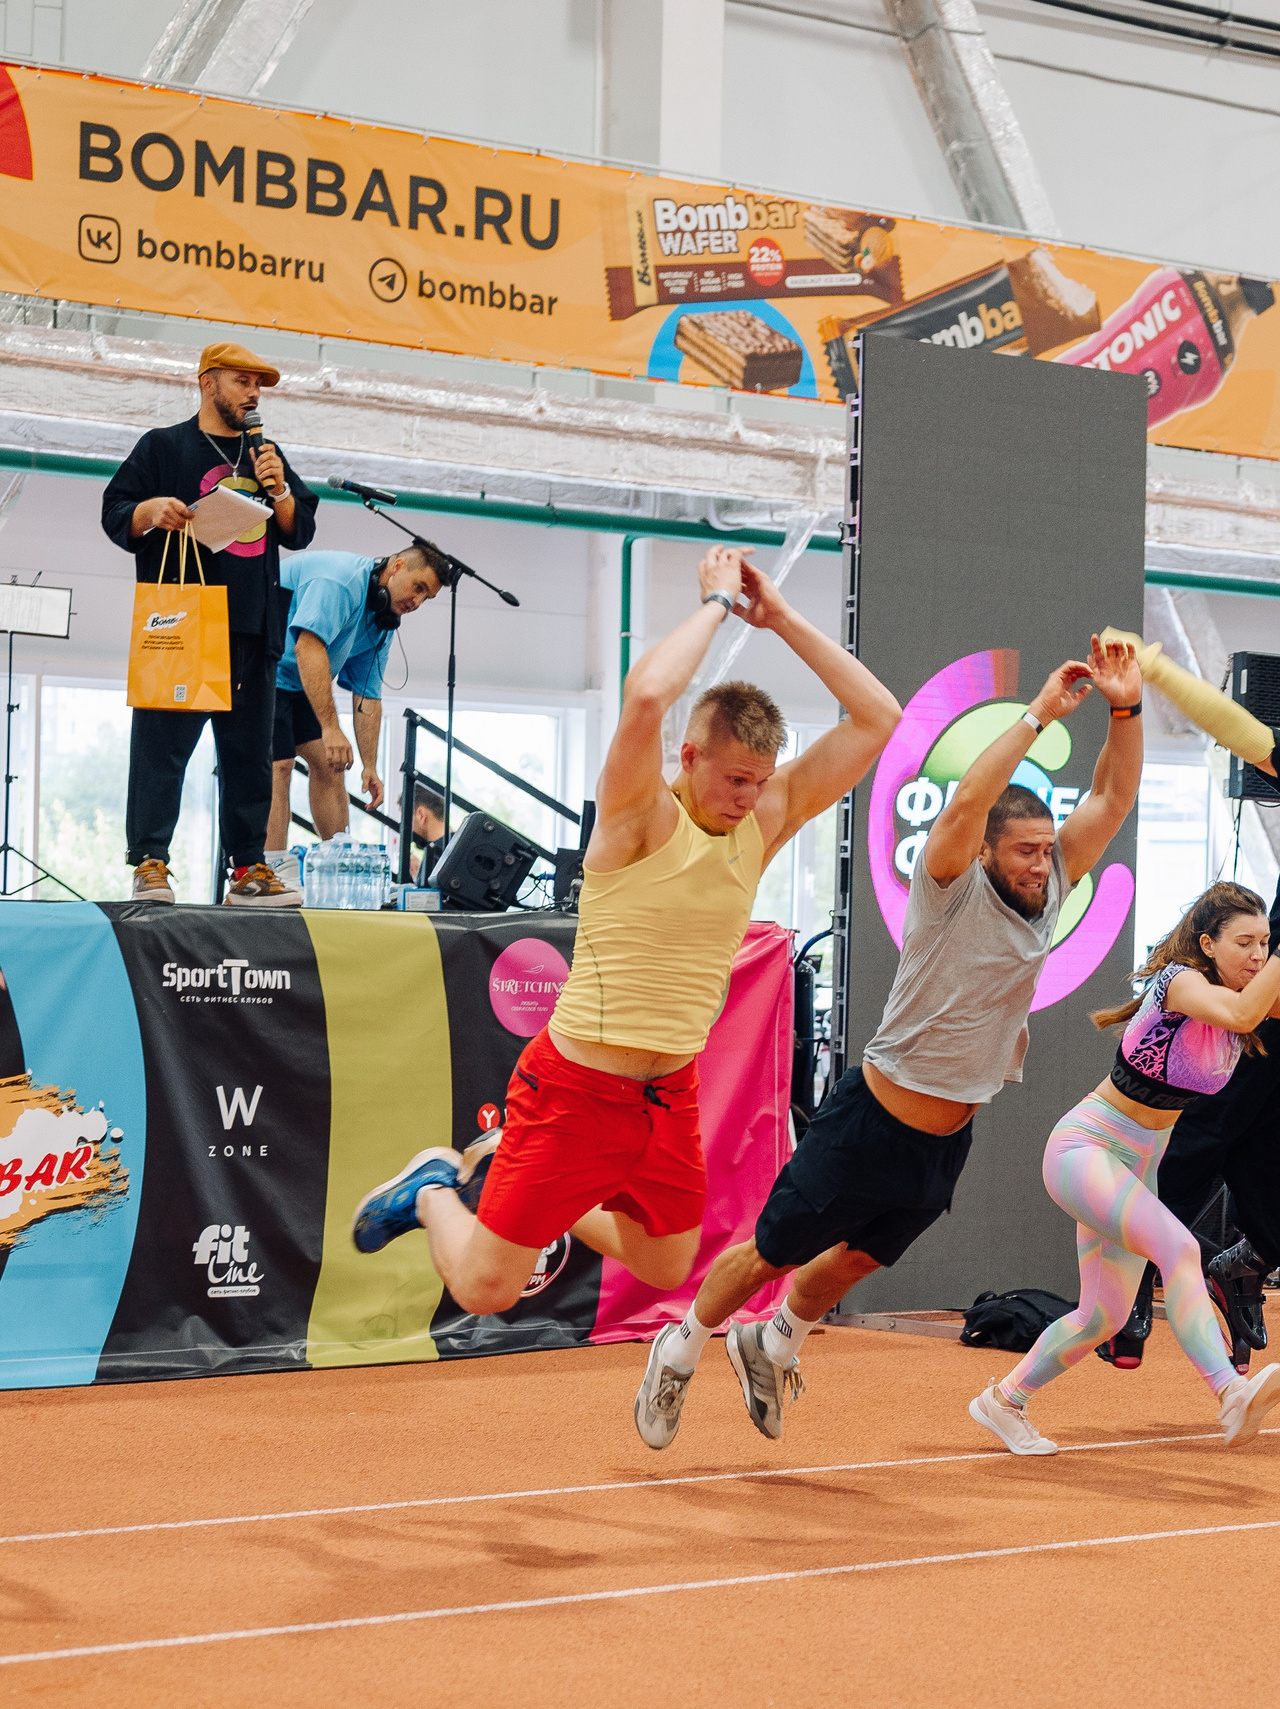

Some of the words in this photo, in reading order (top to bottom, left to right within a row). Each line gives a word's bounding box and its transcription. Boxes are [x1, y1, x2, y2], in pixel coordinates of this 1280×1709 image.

[79, 121, 560, 251] BOMBBAR.RU
[653, 195, 799, 233] Bombbar
[137, 228, 325, 284] bombbarru
[658, 230, 739, 256] WAFER
[749, 246, 782, 263] 22%
[418, 270, 558, 317] bombbar
[1082, 289, 1182, 371] TONIC
[162, 958, 291, 996] SportTown
[216, 1084, 264, 1130] W
[208, 1145, 268, 1157] ZONE
[192, 1224, 250, 1265] fit
